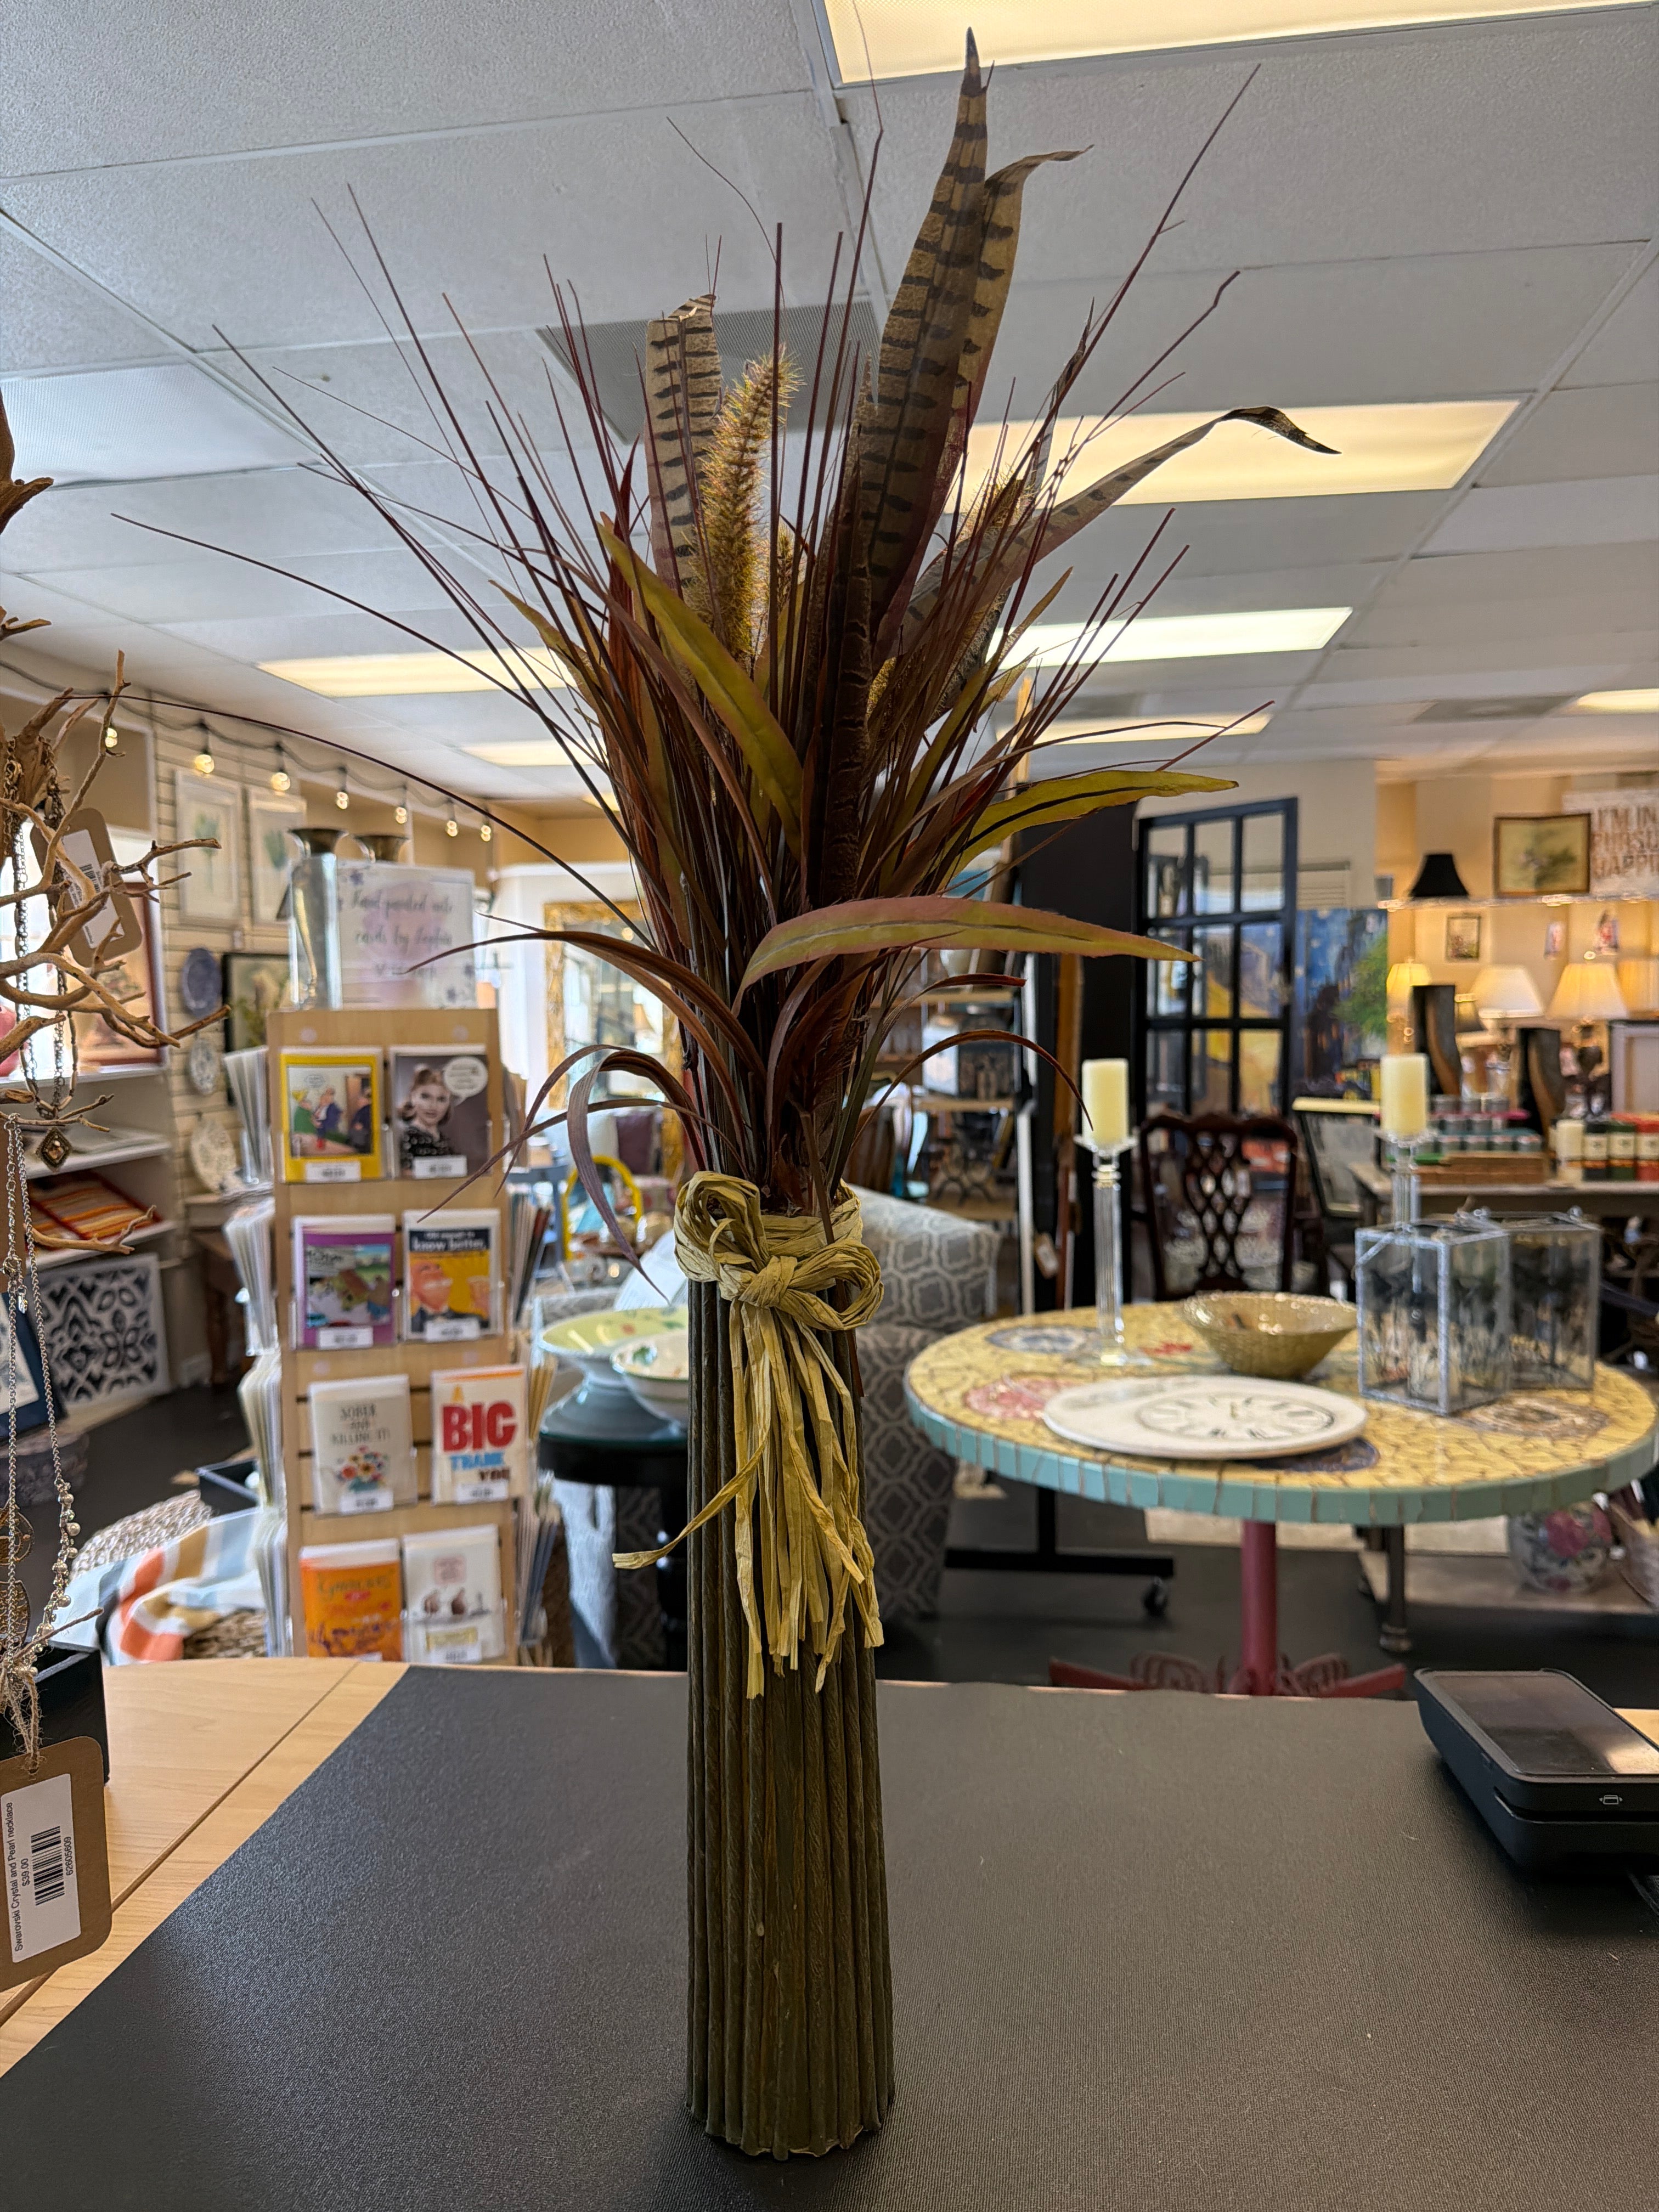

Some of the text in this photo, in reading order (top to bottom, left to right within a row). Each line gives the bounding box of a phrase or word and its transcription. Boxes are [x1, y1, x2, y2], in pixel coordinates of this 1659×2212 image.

[443, 1402, 518, 1452] BIG
[450, 1451, 505, 1471] THANK
[5, 1802, 23, 1952] Swarovski Crystal and Pearl necklace
[21, 1858, 31, 1886] $39.00
